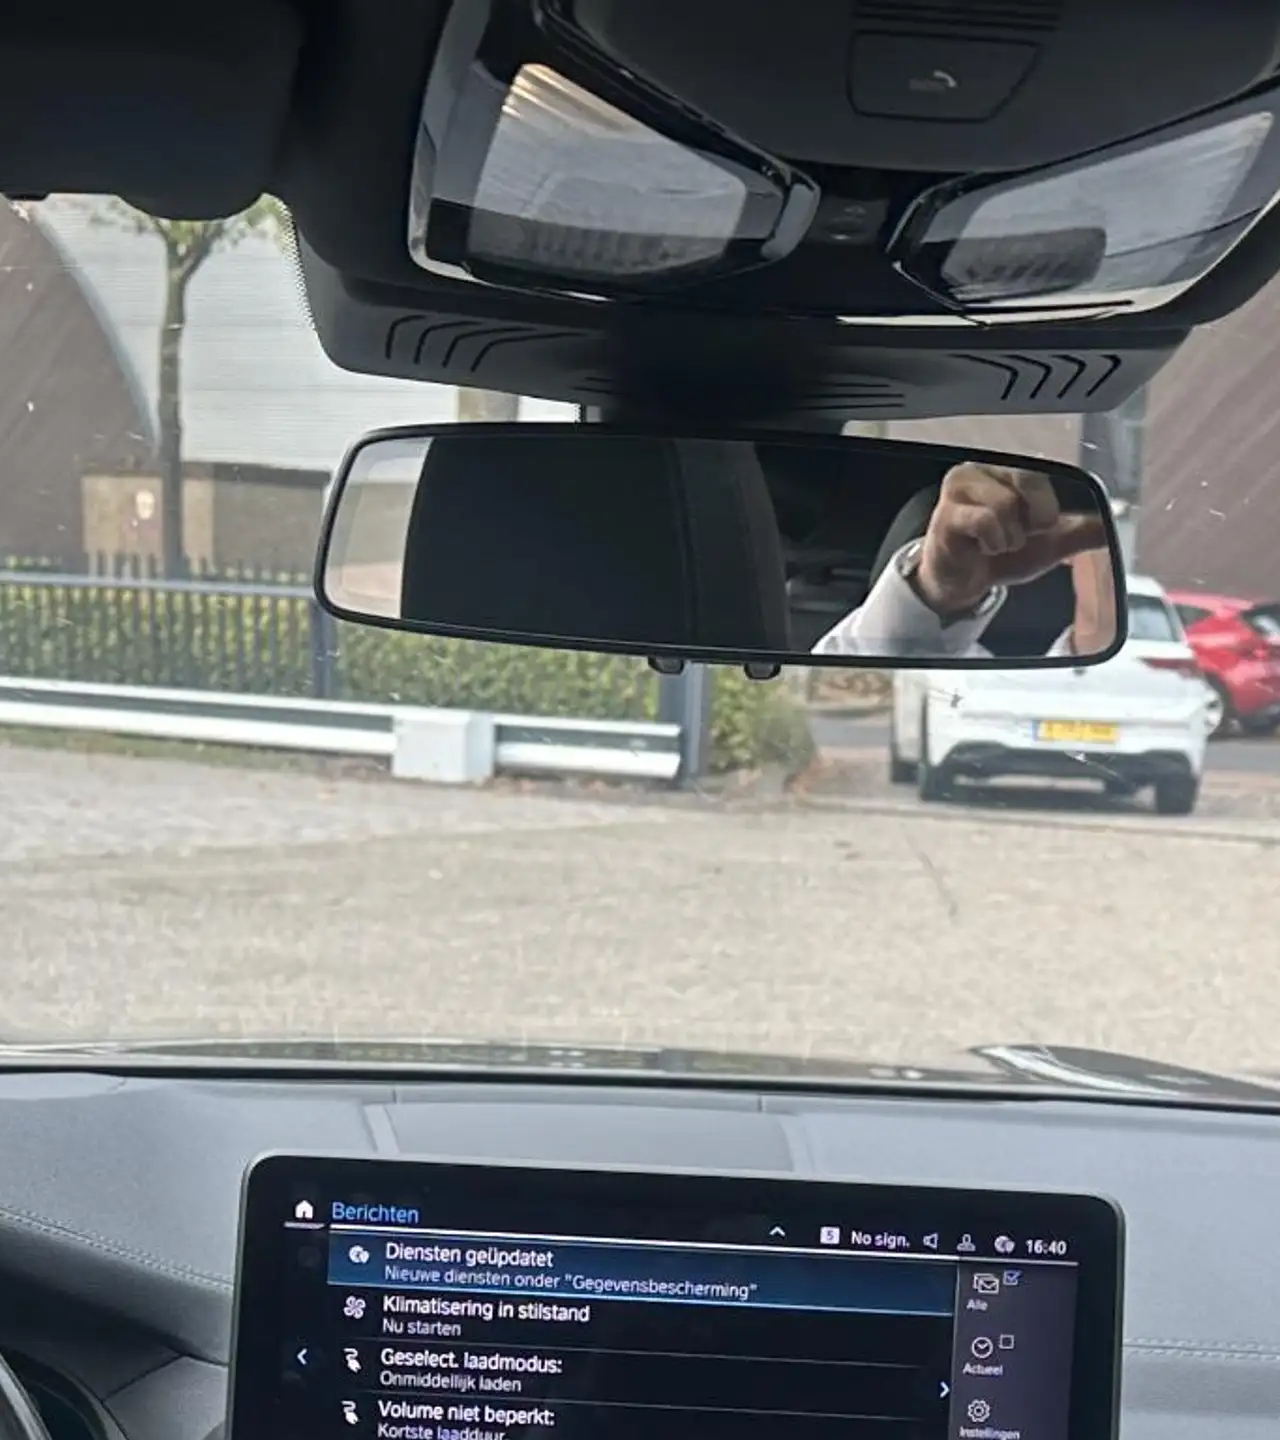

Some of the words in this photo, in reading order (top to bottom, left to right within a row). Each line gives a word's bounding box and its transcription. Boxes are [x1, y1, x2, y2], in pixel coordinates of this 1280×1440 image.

[332, 1202, 419, 1224] Berichten
[851, 1231, 872, 1246] No
[874, 1232, 911, 1250] sign.
[1026, 1239, 1067, 1256] 16:40
[385, 1242, 461, 1263] Diensten
[465, 1246, 554, 1268] geüpdatet
[384, 1265, 440, 1283] Nieuwe
[444, 1268, 511, 1287] diensten
[514, 1271, 559, 1288] onder
[565, 1273, 758, 1300] "Gegevensbescherming"
[383, 1295, 493, 1321] Klimatisering
[498, 1301, 513, 1318] in
[517, 1301, 590, 1322] stilstand
[967, 1299, 988, 1311] Alle
[383, 1318, 403, 1334] Nu
[407, 1320, 461, 1337] starten
[380, 1348, 458, 1369] Geselect.
[464, 1351, 563, 1374] laadmodus:
[380, 1370, 475, 1392] Onmiddellijk
[479, 1376, 522, 1392] laden
[377, 1401, 444, 1421] Volume
[447, 1404, 480, 1422] niet
[484, 1406, 556, 1427] beperkt:
[377, 1423, 433, 1440] Kortste
